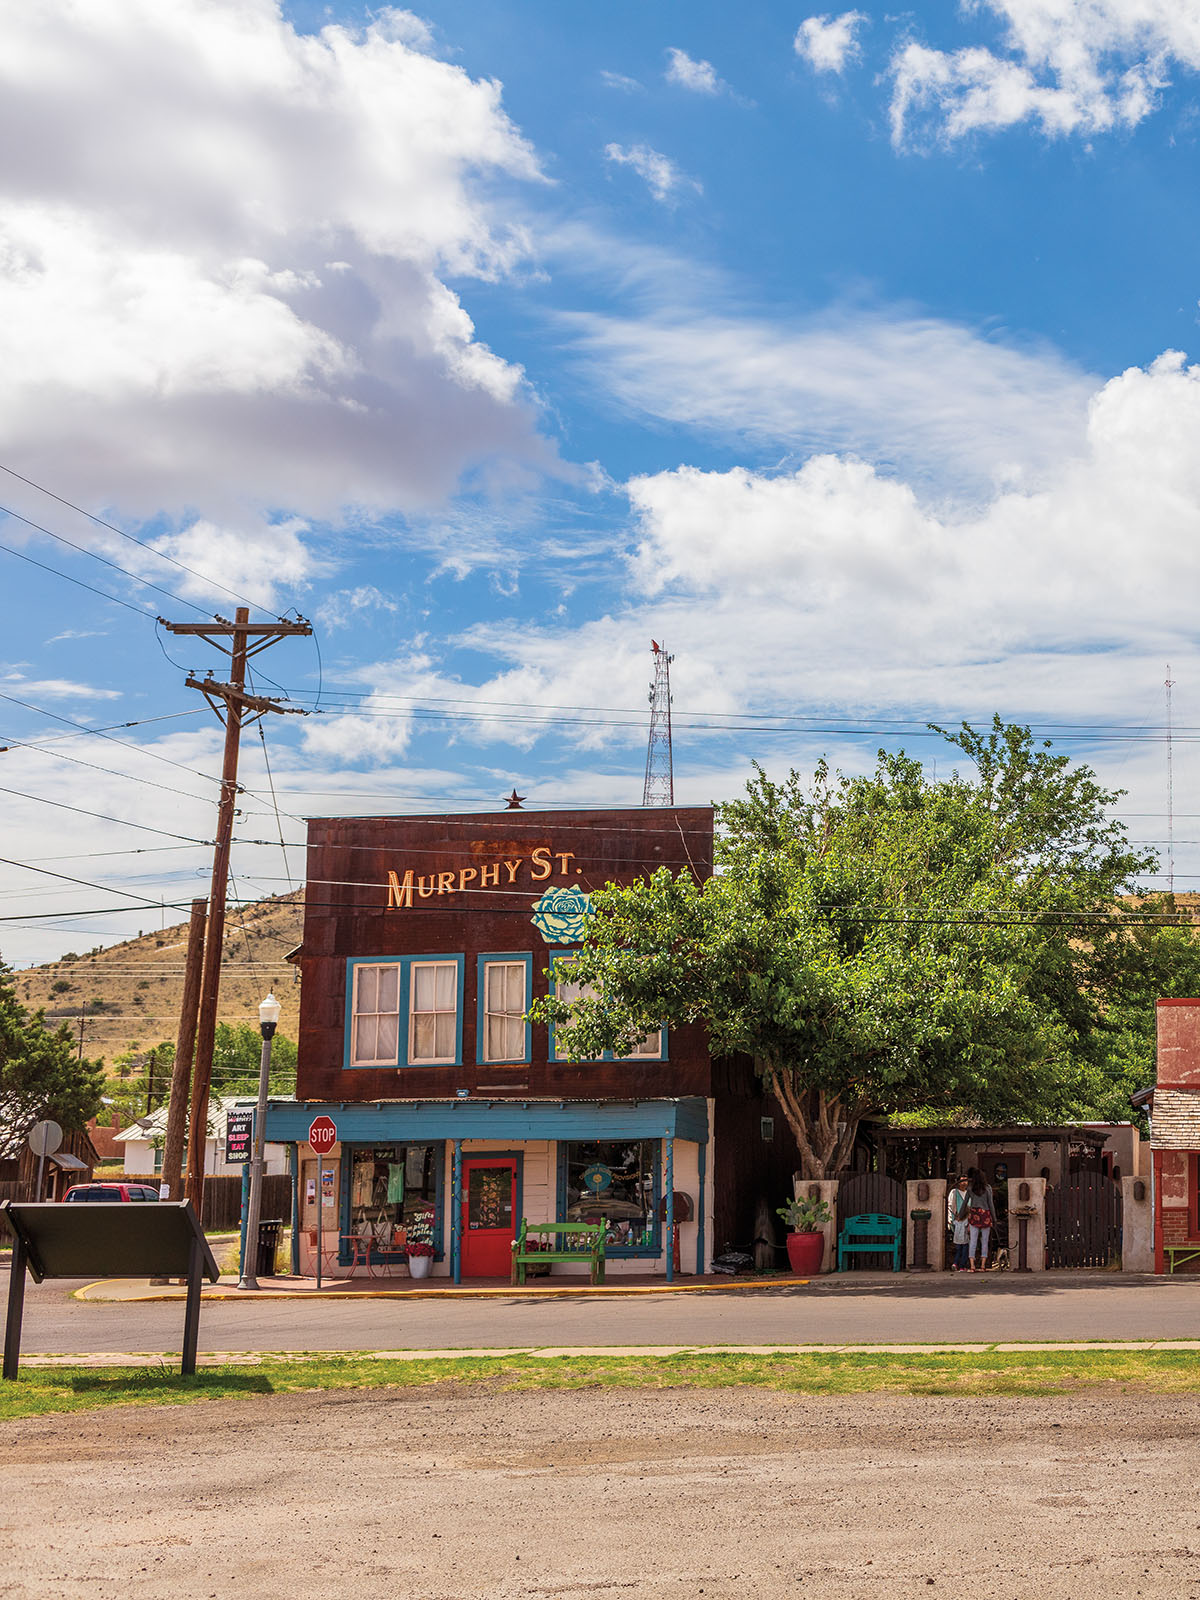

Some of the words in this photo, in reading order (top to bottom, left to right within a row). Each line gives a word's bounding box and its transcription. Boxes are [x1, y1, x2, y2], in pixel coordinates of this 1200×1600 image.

[386, 858, 523, 911] MURPHY
[530, 847, 583, 881] ST.
[231, 1124, 246, 1132] ART
[228, 1133, 249, 1141] SLEEP
[311, 1128, 334, 1143] STOP
[228, 1152, 249, 1160] SHOP
[414, 1212, 434, 1222] Gifts
